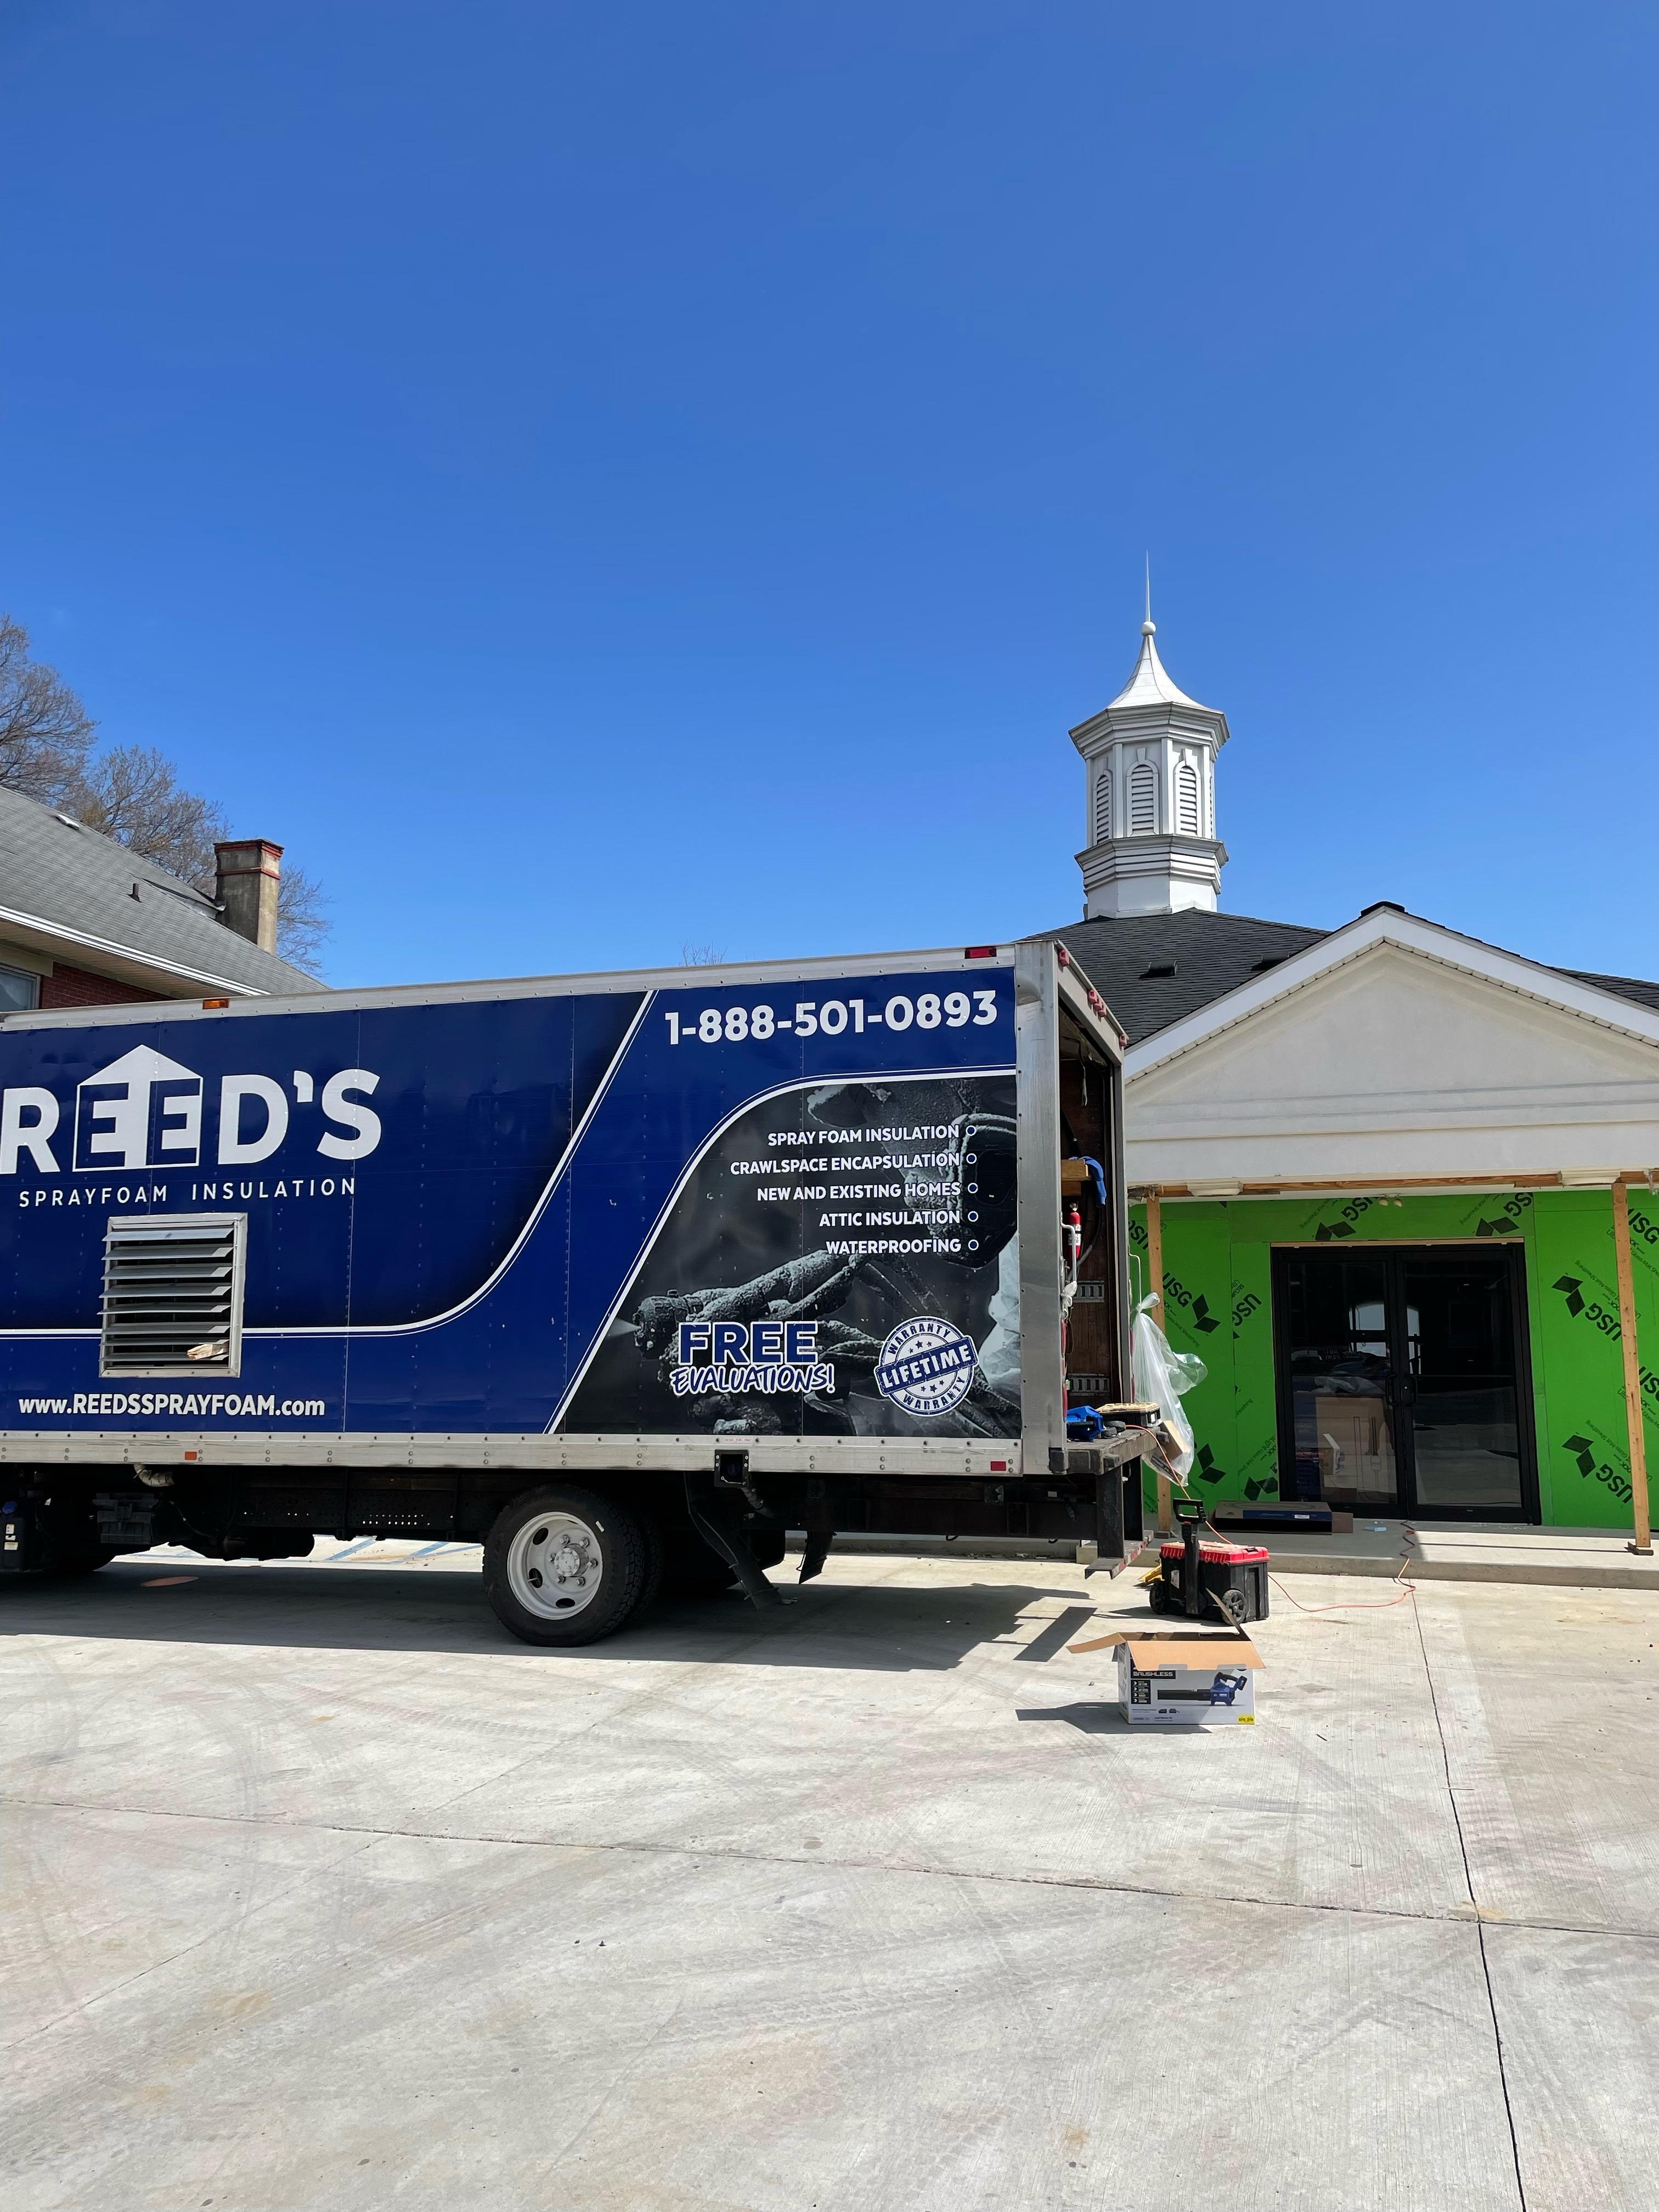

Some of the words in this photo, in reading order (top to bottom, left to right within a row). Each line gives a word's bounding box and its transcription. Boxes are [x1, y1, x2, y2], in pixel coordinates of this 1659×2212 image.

[664, 990, 998, 1045] 1-888-501-0893
[0, 1069, 382, 1174] REED'S
[768, 1130, 816, 1147] SPRAY
[818, 1128, 862, 1144] FOAM
[865, 1125, 960, 1143] INSULATION
[730, 1158, 828, 1176] CRAWLSPACE
[831, 1152, 960, 1172] ENCAPSULATION
[19, 1185, 168, 1207] SPRAYFOAM
[191, 1178, 356, 1200] INSULATION
[757, 1186, 792, 1201] NEW
[793, 1186, 826, 1200] AND
[830, 1183, 901, 1199] EXISTING
[904, 1181, 961, 1198] HOMES
[1503, 1193, 1533, 1216] SG
[819, 1212, 862, 1228] ATTIC
[865, 1210, 961, 1226] INSULATION
[826, 1238, 962, 1255] WATERPROOFING
[1163, 1272, 1193, 1308] USG
[1232, 1294, 1262, 1327] USG
[1585, 1303, 1622, 1341] USG
[679, 1321, 818, 1365] FREE
[888, 1323, 951, 1355] WARRANTY
[670, 1365, 835, 1396] EVALUATIONS!
[882, 1345, 972, 1389] LIFETIME
[19, 1393, 325, 1417] www.REEDSSPRAYFOAM.com
[903, 1376, 966, 1410] WARRANTY
[1596, 1464, 1633, 1504] USG
